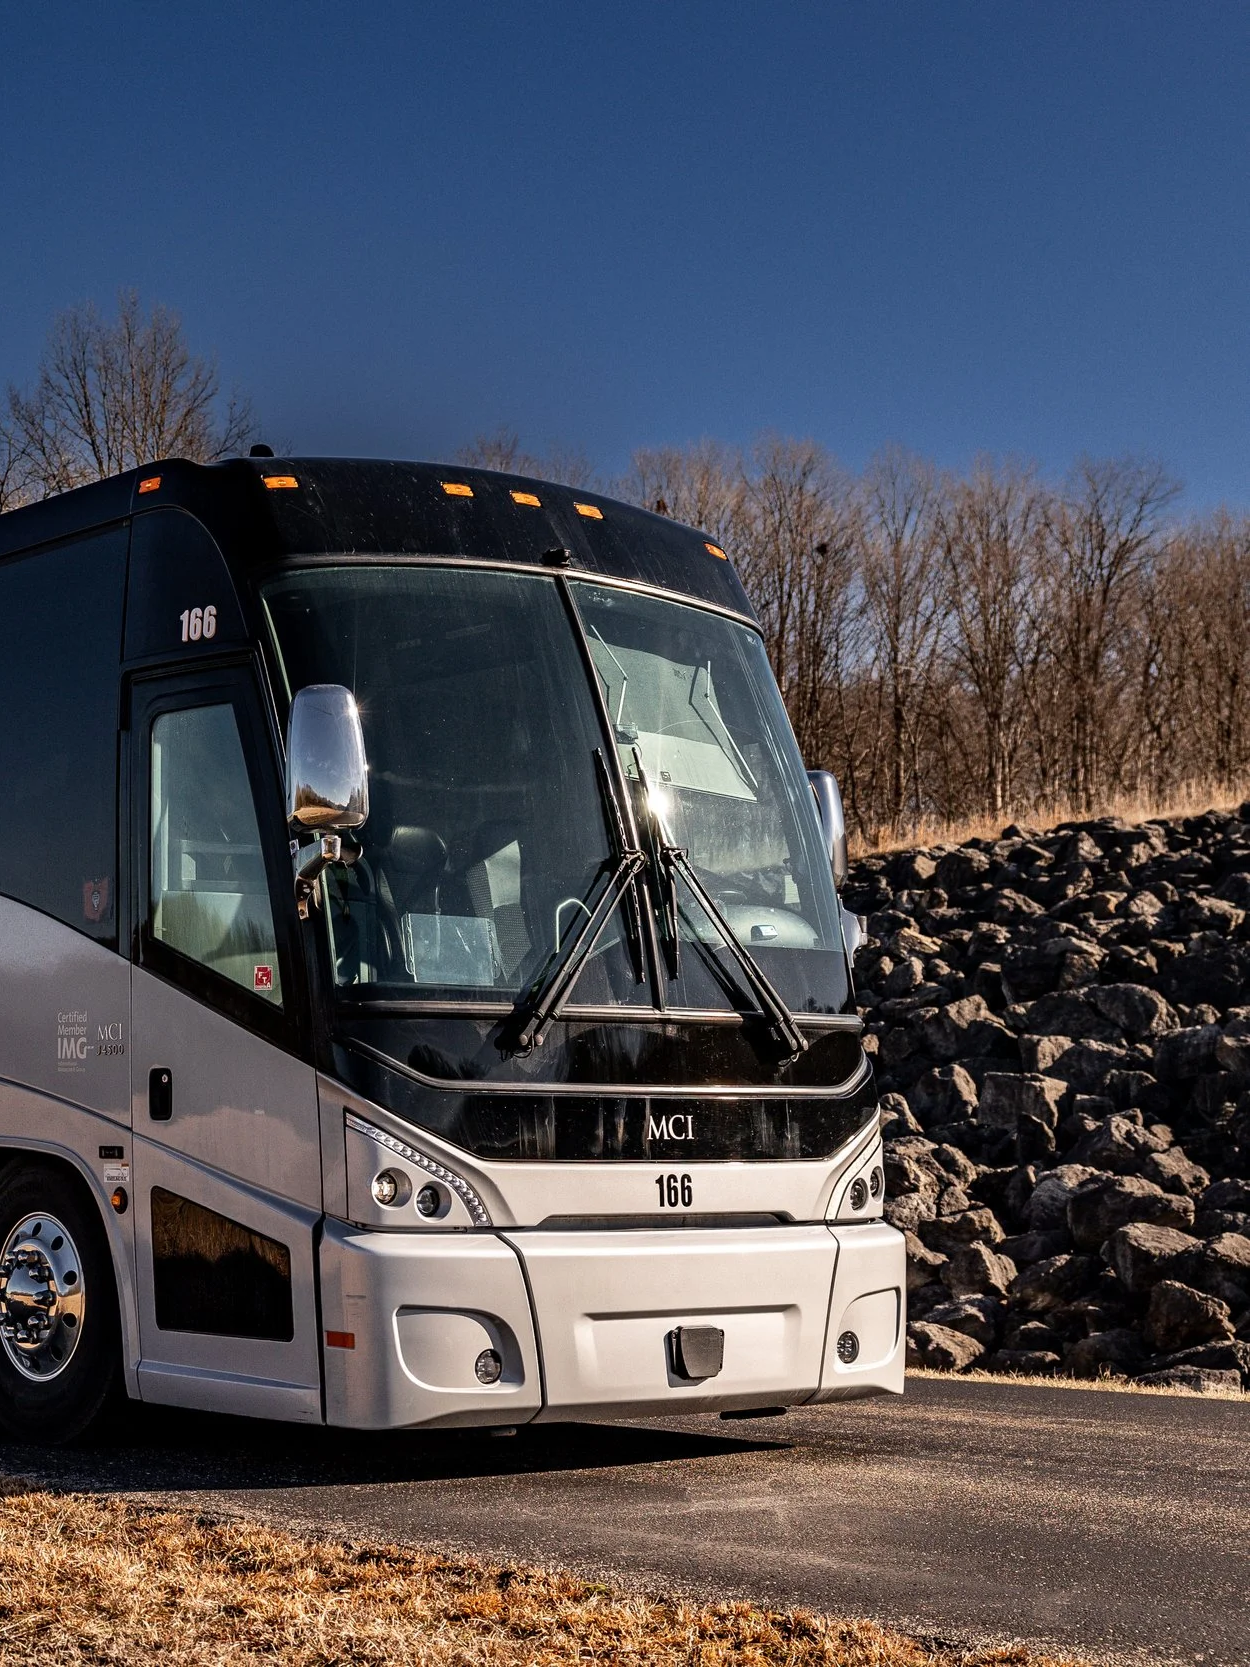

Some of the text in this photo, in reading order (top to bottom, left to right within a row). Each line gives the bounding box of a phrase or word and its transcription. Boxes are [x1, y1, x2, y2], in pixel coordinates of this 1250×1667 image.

[179, 604, 217, 643] 166
[57, 1010, 88, 1023] Certified
[57, 1024, 87, 1036] Member
[97, 1023, 123, 1041] MCI
[57, 1036, 87, 1059] IMG
[96, 1044, 125, 1056] J4500
[646, 1114, 695, 1140] MCI
[655, 1173, 693, 1208] 166
